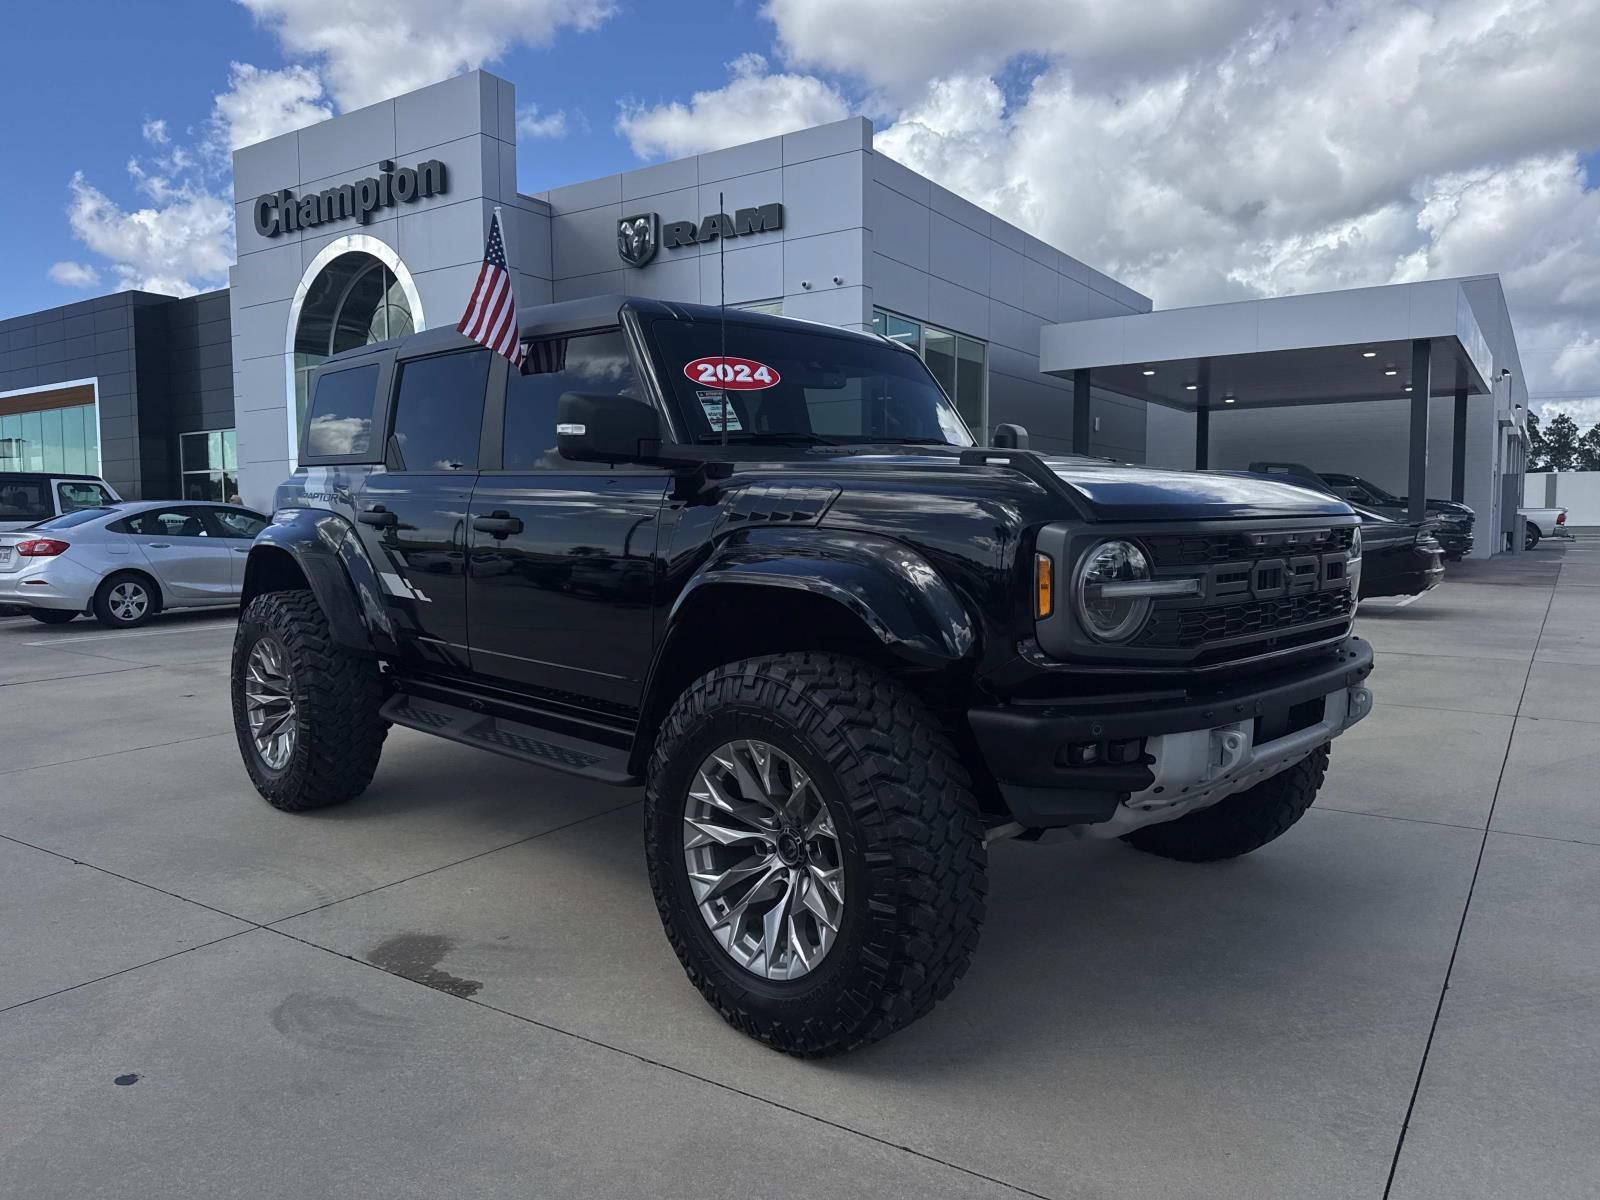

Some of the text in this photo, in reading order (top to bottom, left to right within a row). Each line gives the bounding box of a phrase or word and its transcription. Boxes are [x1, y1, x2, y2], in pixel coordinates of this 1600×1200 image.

[254, 159, 447, 237] Champion
[663, 203, 783, 248] RAM
[697, 363, 772, 383] 2024
[303, 492, 338, 504] RAPTOR
[1208, 552, 1346, 600] FORD
